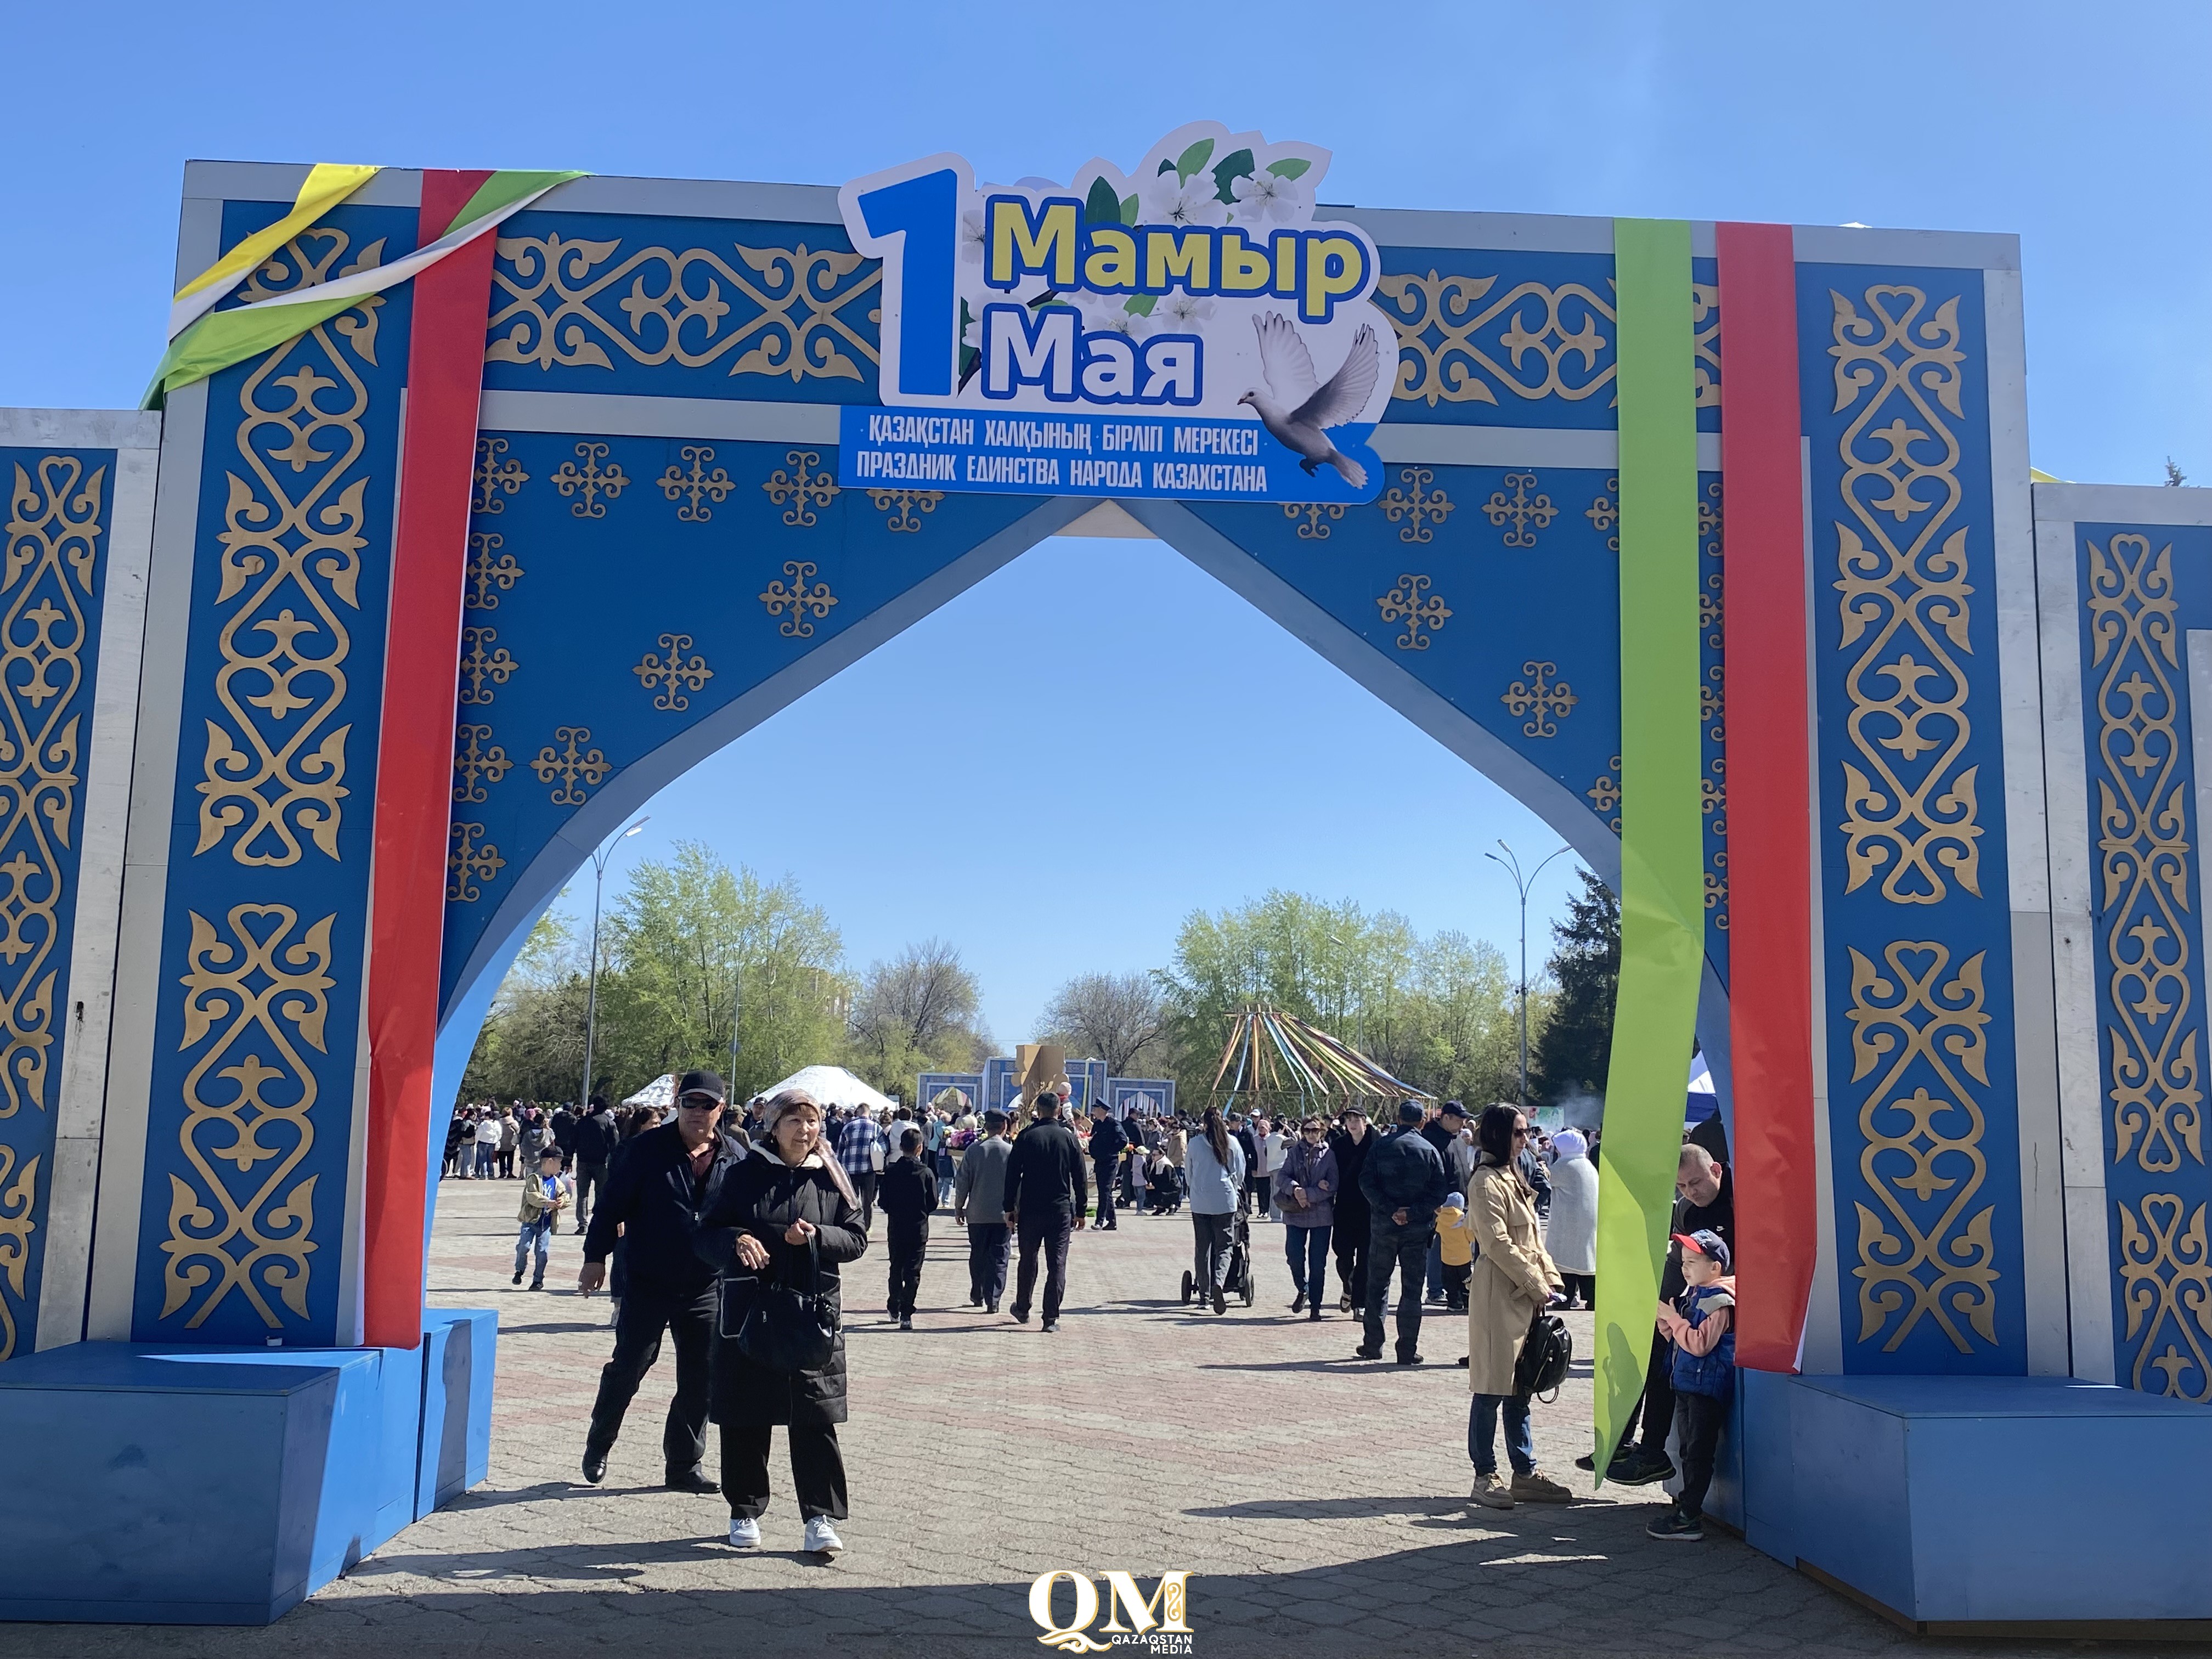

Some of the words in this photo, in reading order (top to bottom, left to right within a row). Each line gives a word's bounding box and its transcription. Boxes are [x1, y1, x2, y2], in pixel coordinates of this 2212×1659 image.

[857, 169, 957, 395] 1
[985, 193, 1370, 326] Мамыр
[981, 303, 1204, 407] Мая
[856, 451, 956, 481] ПРАЗДНИК
[967, 455, 1059, 485] ЕДИНСТВА
[1070, 459, 1142, 488] НАРОДА
[1153, 462, 1267, 492] КАЗАХСТАНА
[869, 415, 974, 448] ҚАЗАҚСТАН
[985, 419, 1092, 455] ХАЛҚЫНЫҢ
[1103, 425, 1163, 452] БІРЛІГІ
[1174, 426, 1258, 456] МЕРЕКЕСІ
